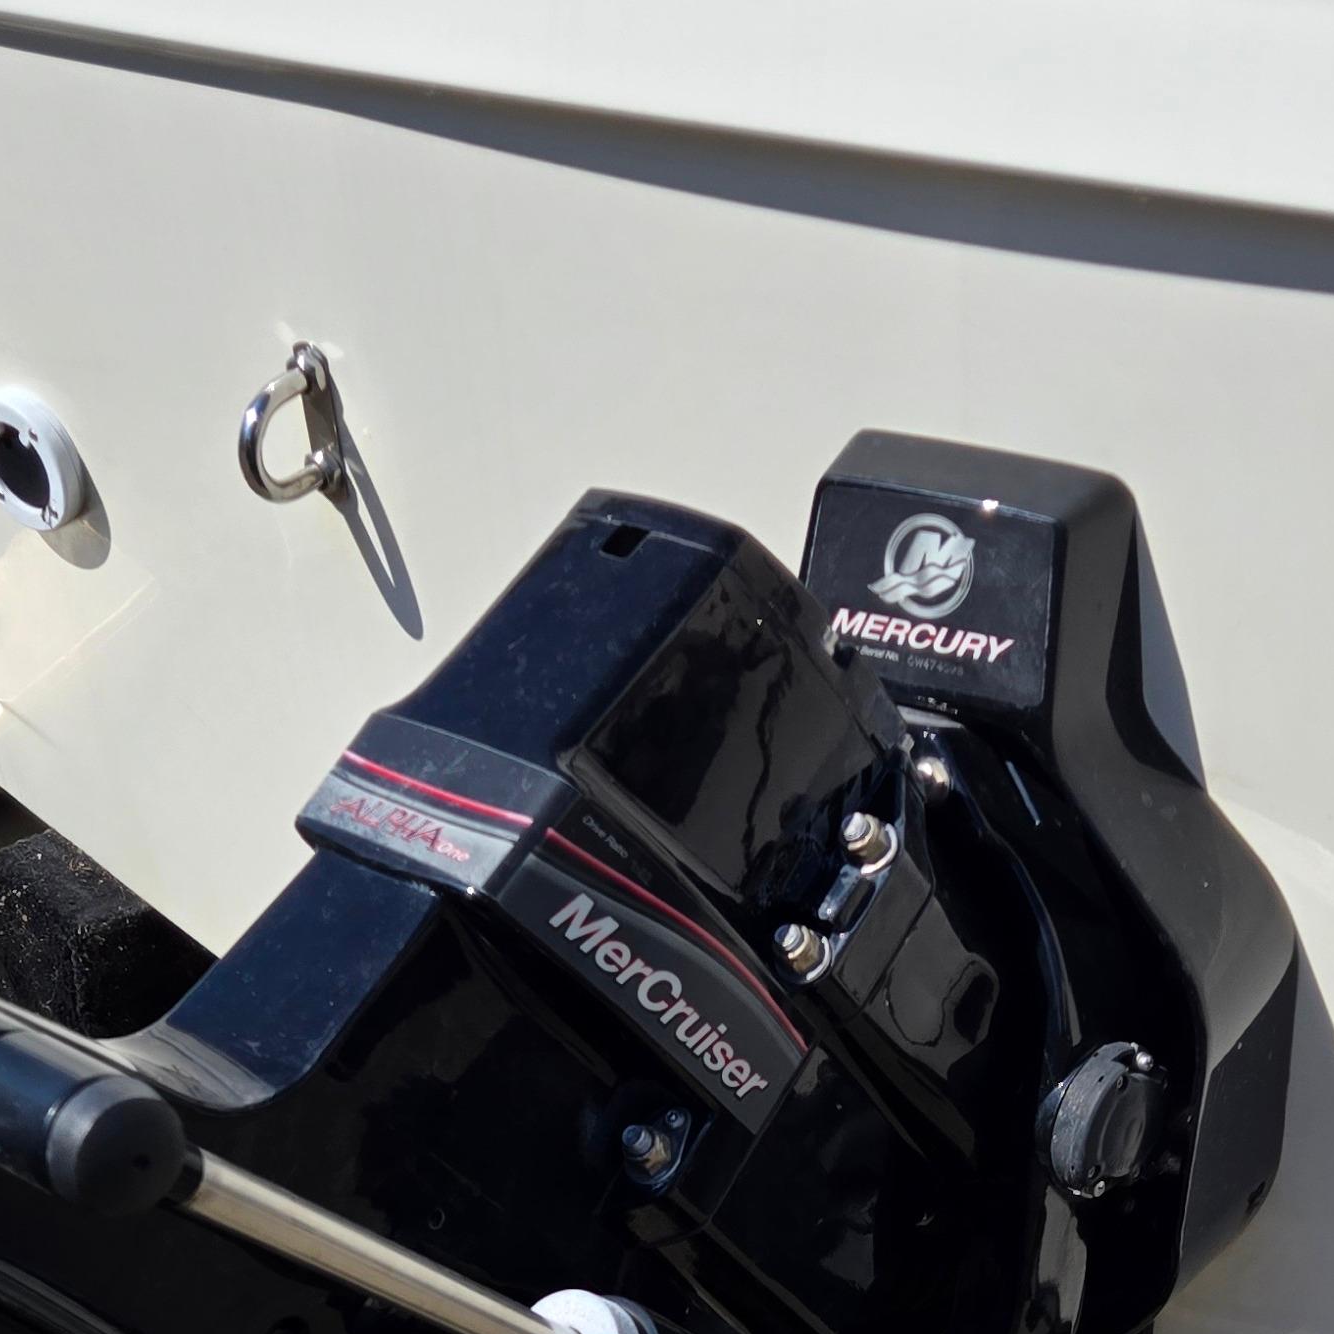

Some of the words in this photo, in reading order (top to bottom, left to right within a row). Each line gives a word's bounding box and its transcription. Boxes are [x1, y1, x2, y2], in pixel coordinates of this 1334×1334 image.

[832, 607, 1015, 663] MERCURY
[331, 797, 443, 852] ALPHA
[581, 814, 606, 838] Drive
[604, 834, 629, 859] Ratio
[548, 893, 769, 1100] MerCruiser
